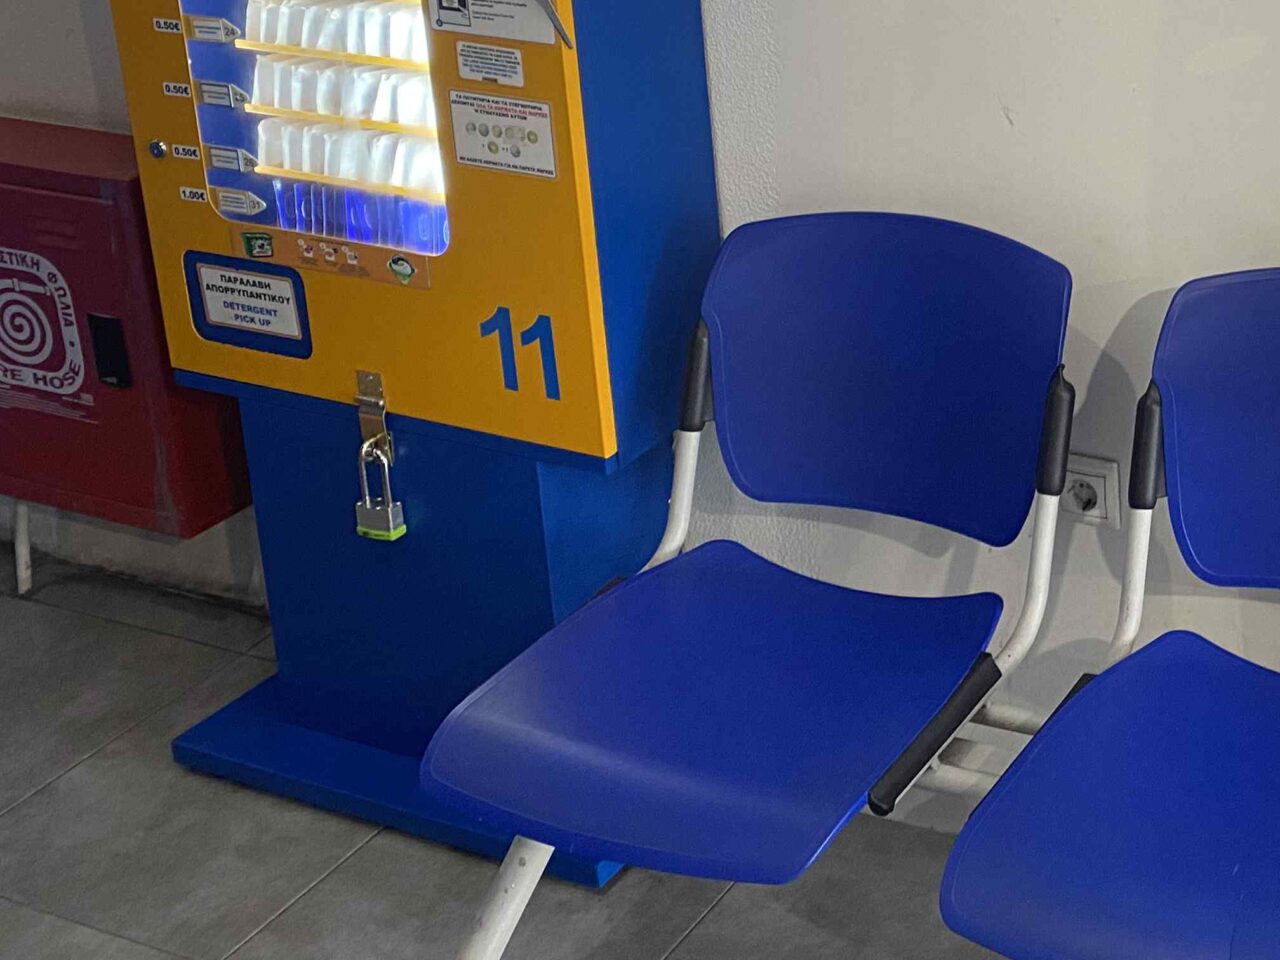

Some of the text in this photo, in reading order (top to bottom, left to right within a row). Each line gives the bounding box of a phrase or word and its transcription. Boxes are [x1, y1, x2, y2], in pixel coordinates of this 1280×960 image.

[155, 20, 180, 31] 0.50€
[165, 85, 189, 95] 0.50€
[174, 147, 198, 158] 0.50€
[182, 190, 205, 201] 1.00€
[220, 274, 271, 290] ΠΑΡΑΛΑΒΗ
[206, 284, 291, 305] ΑΠΟΡΡΥΠΑΝΤΙΚΟΥ
[223, 301, 278, 317] DETERGENT
[235, 314, 271, 327] PICK UP
[480, 307, 560, 400] 11
